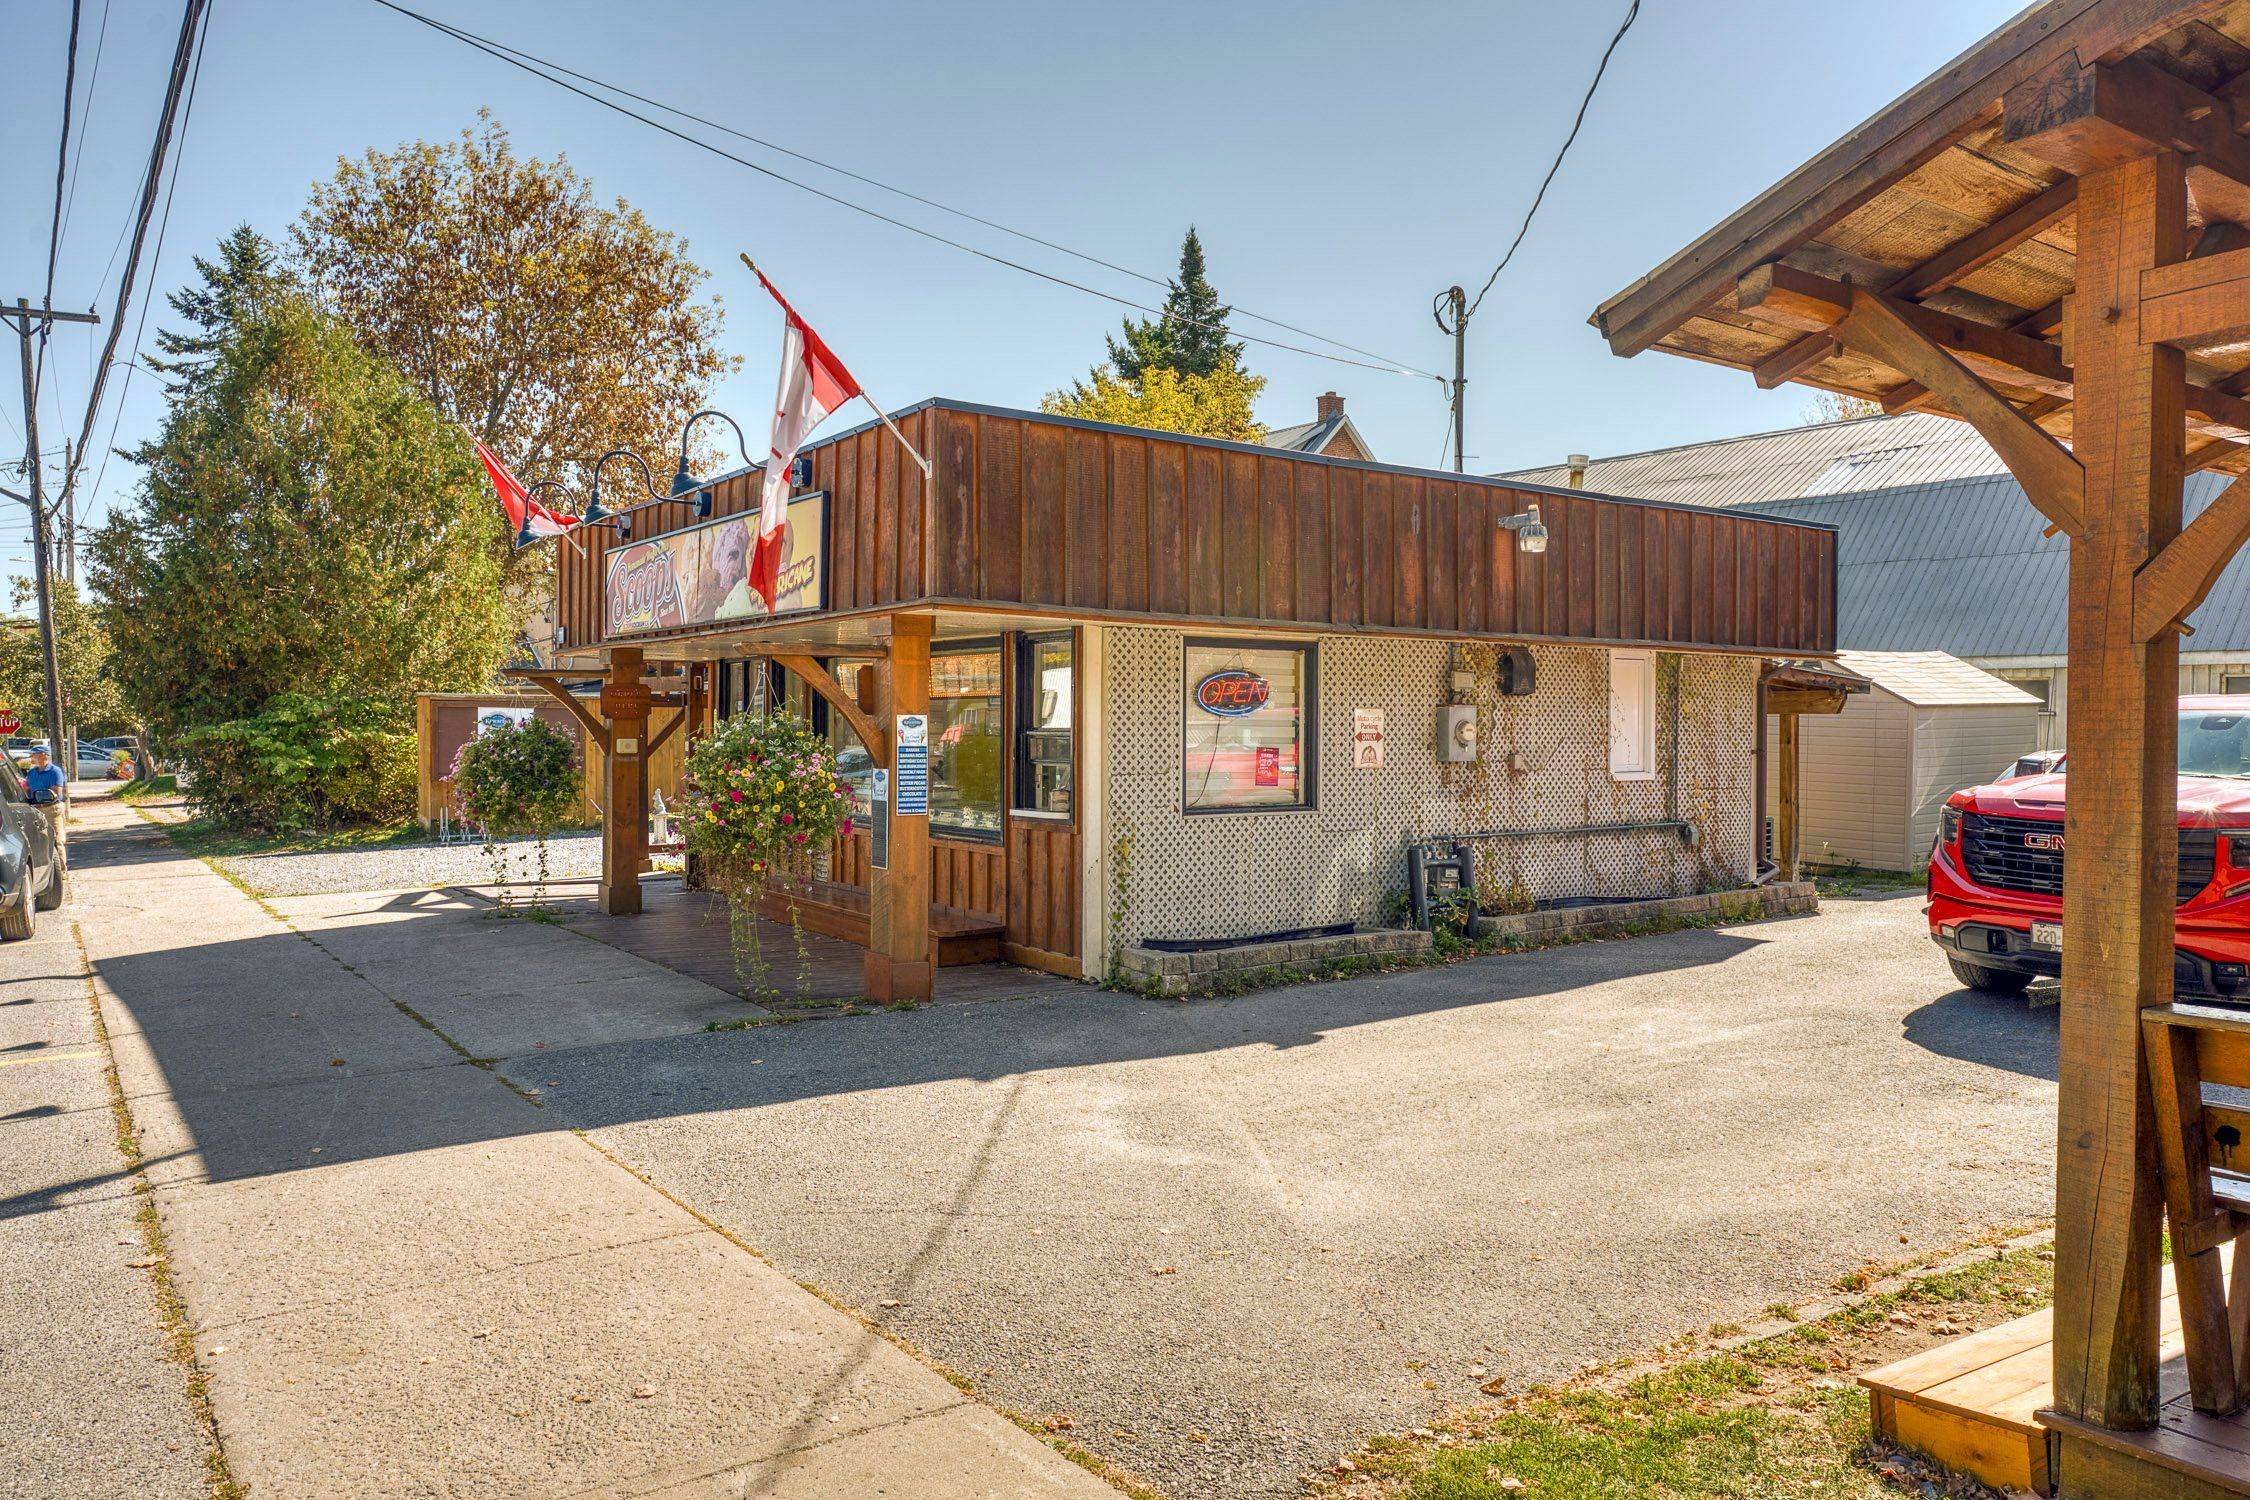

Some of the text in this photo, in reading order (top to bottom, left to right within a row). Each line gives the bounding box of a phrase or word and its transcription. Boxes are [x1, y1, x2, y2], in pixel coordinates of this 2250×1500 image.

[775, 558, 813, 597] RICANE
[613, 548, 677, 628] Scoops
[1202, 681, 1270, 704] OPEN
[0, 717, 19, 727] TOP
[1357, 715, 1382, 723] Motocycle
[1360, 722, 1379, 730] Parking
[1361, 733, 1376, 741] ONLY
[2024, 832, 2065, 850] GM
[2037, 929, 2057, 944] 220
